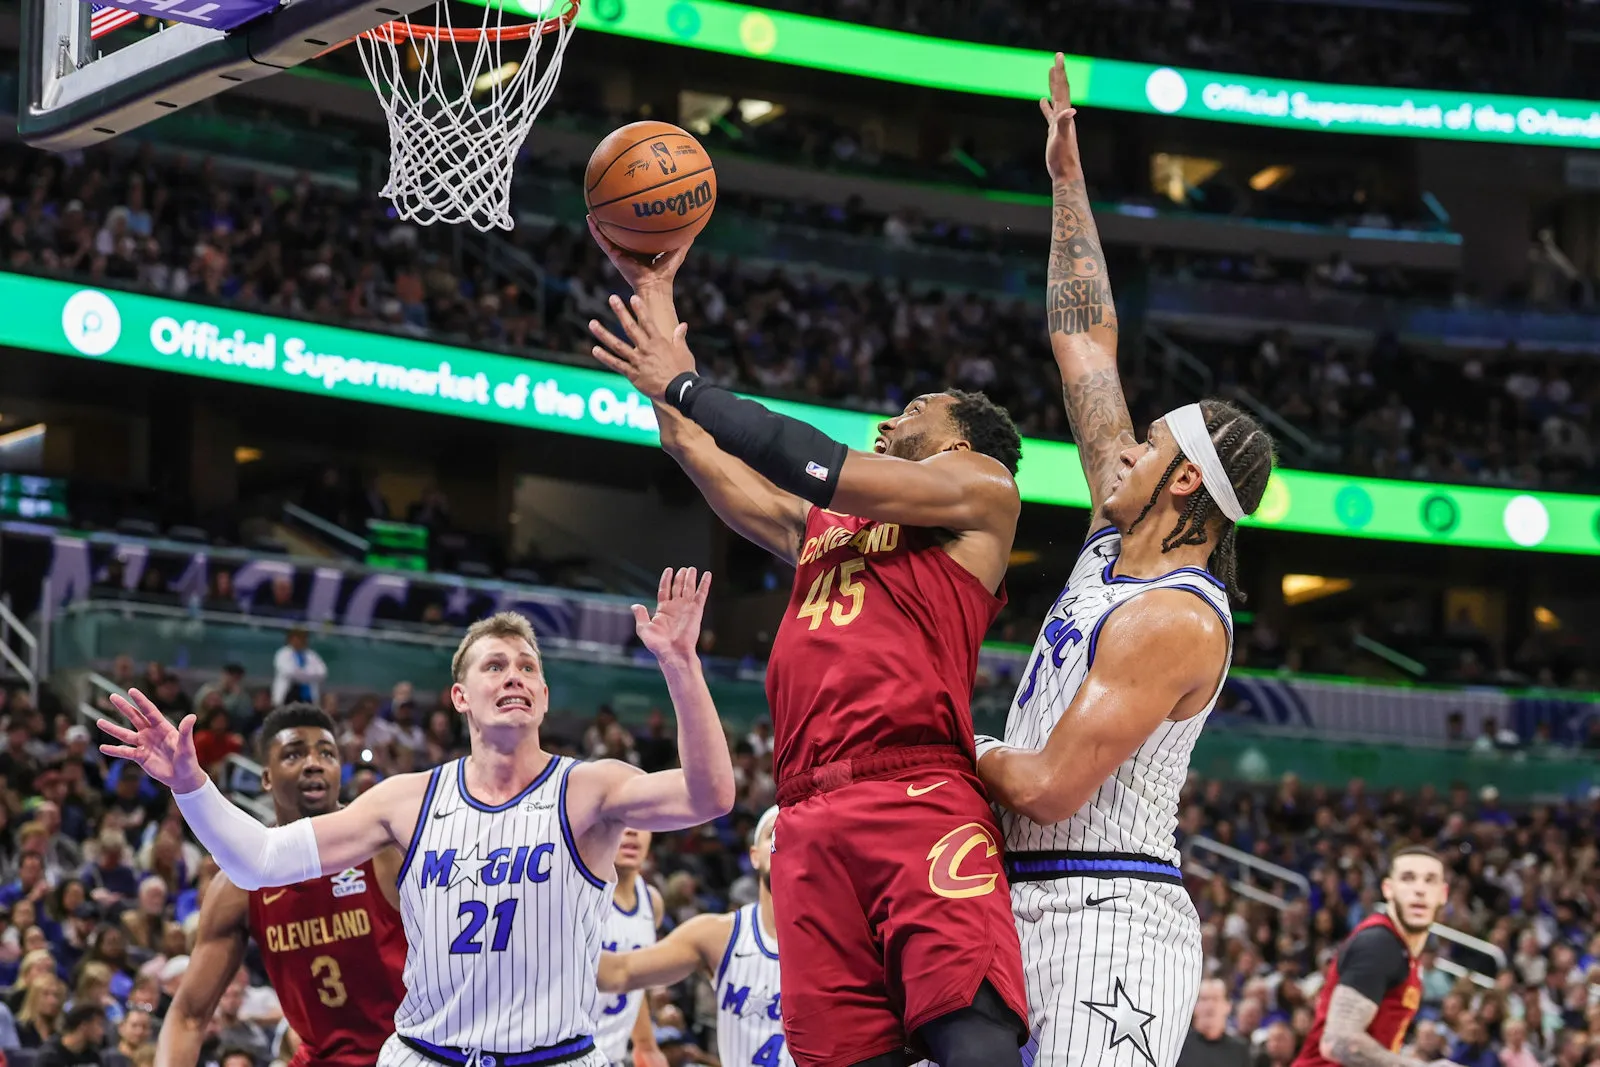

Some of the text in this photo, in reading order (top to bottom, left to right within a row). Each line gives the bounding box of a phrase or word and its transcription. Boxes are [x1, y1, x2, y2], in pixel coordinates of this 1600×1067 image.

[1443, 102, 1473, 130] of
[1473, 104, 1516, 133] the
[632, 179, 713, 218] Wilson
[150, 316, 276, 371] Official
[282, 337, 490, 405] Supermarket
[494, 373, 530, 410] of
[532, 378, 585, 420] the
[796, 556, 866, 631] 45
[266, 908, 371, 953] CLEVELAND
[449, 898, 519, 955] 21
[310, 955, 348, 1008] 3
[752, 1033, 786, 1067] 4
